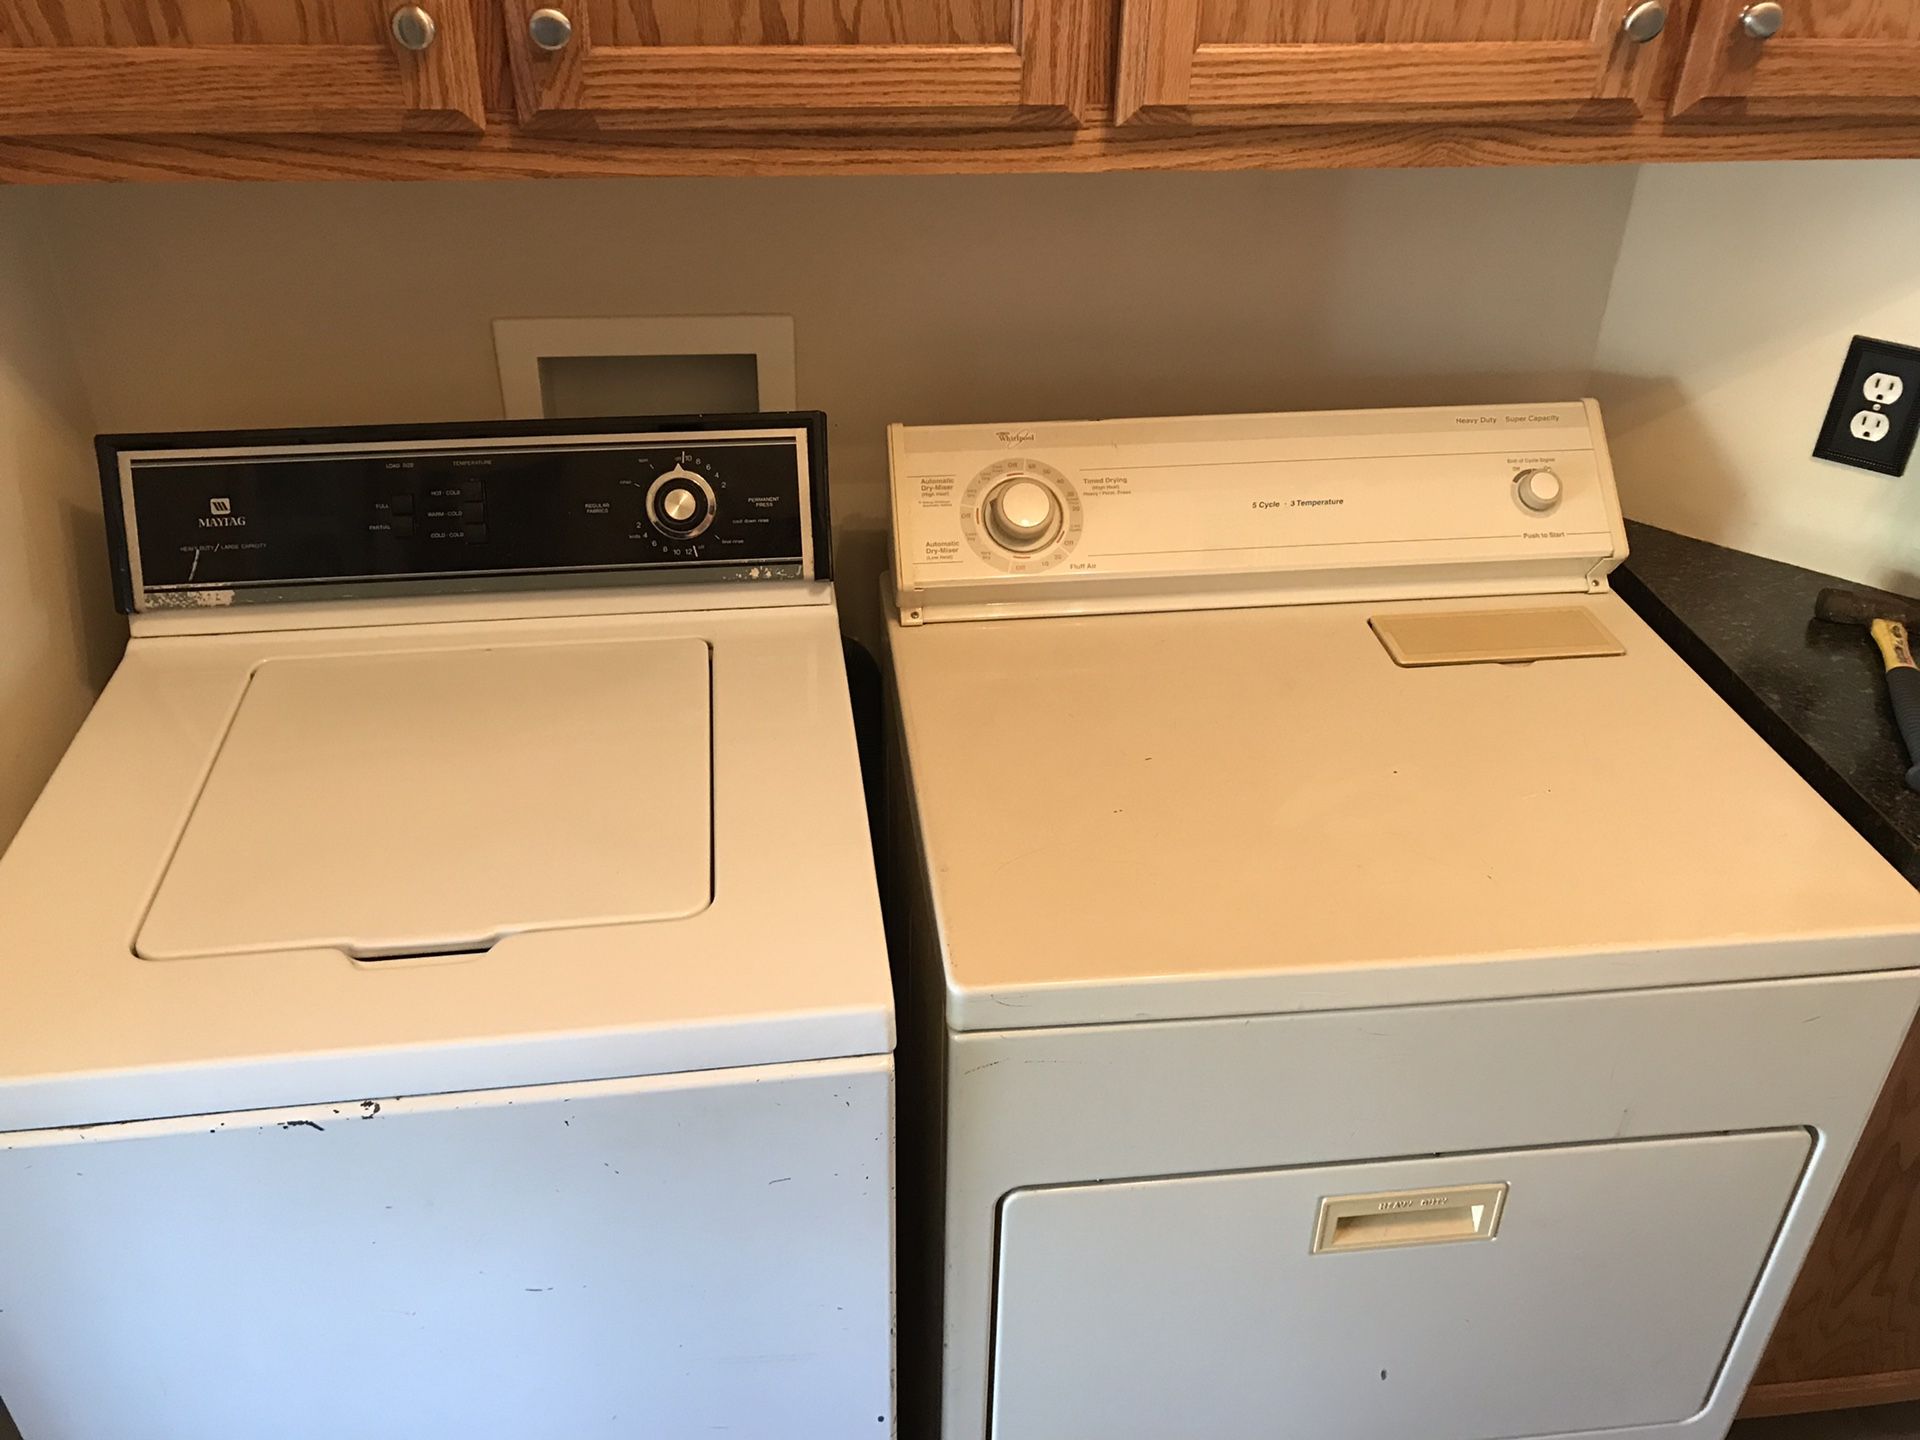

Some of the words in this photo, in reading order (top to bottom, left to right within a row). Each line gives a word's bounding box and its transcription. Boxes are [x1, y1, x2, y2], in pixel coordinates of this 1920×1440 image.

[996, 431, 1035, 443] Whirlpool
[1252, 501, 1257, 509] 5
[1258, 501, 1280, 509] Cycle
[1297, 499, 1344, 507] Temperature
[198, 516, 246, 528] MAYTAG
[636, 521, 641, 529] 2
[925, 547, 960, 555] Dry-Miser
[1378, 1199, 1414, 1210] HEAVY
[1420, 1197, 1449, 1207] DUTY
